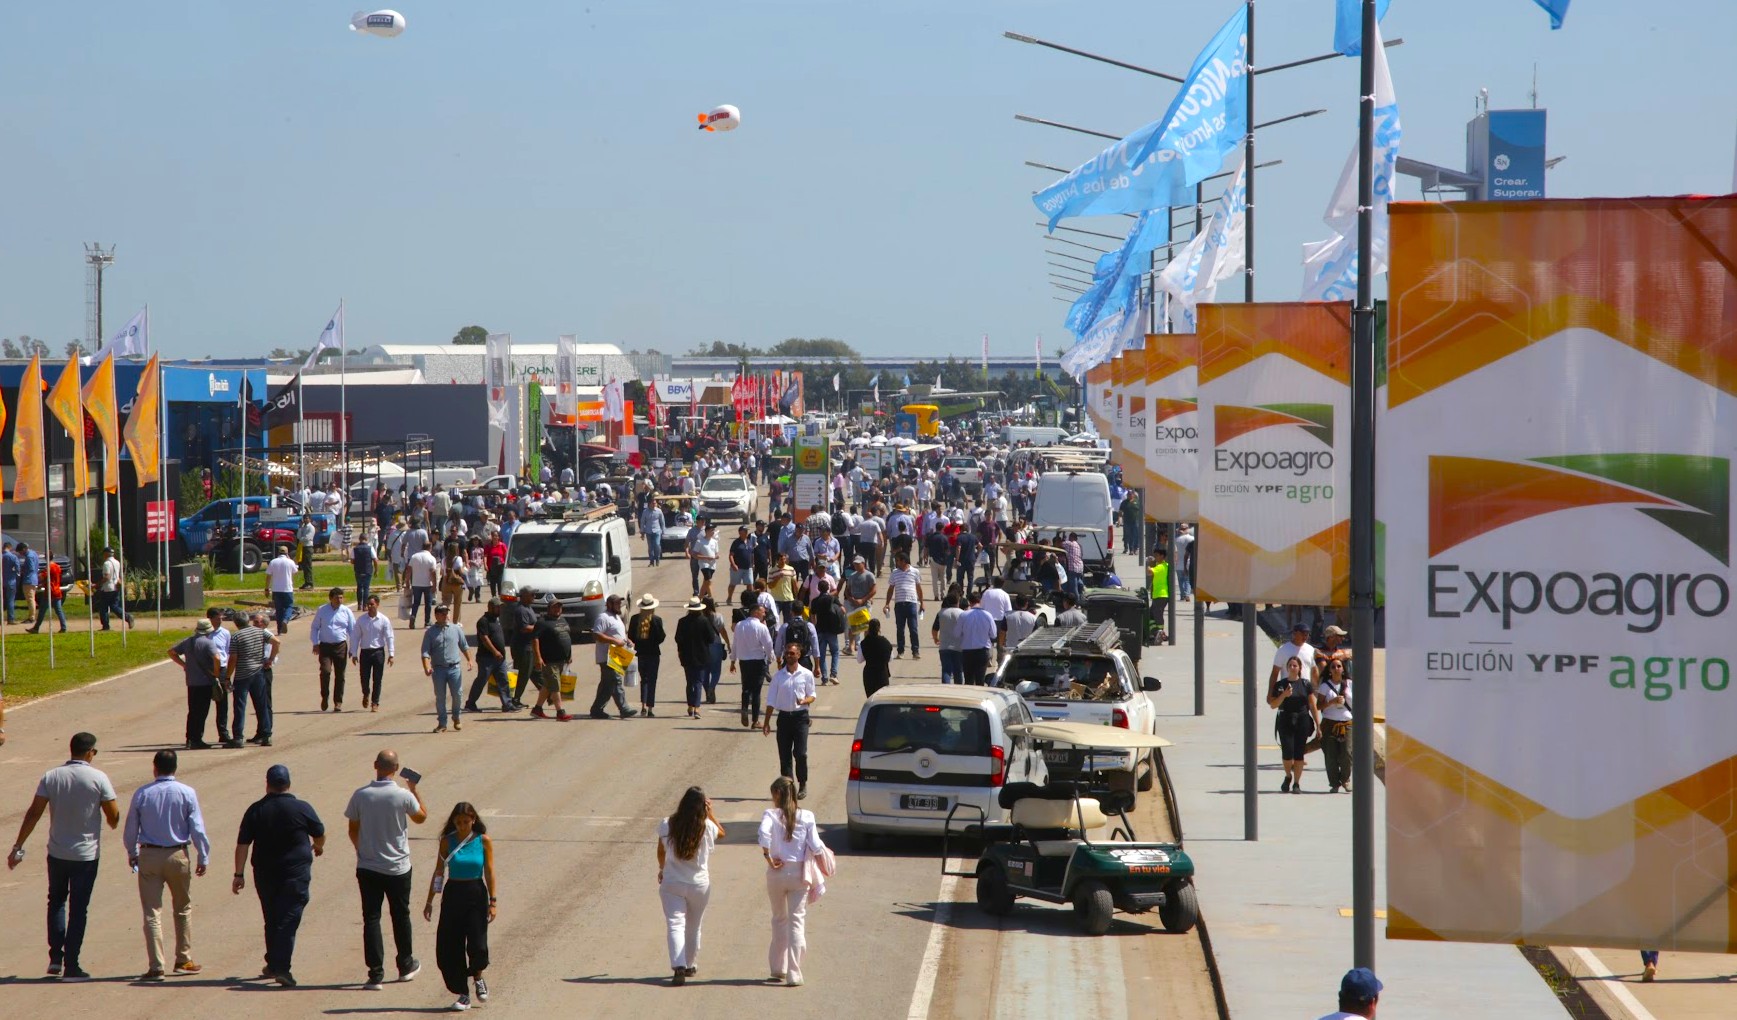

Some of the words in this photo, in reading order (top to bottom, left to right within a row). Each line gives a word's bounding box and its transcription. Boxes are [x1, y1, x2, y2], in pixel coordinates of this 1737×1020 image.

[1494, 178, 1528, 186] Crear.
[1494, 189, 1541, 198] Superar.
[520, 365, 554, 375] JOHN
[577, 367, 598, 375] ERE
[1156, 426, 1198, 443] Expo
[1214, 449, 1334, 476] Expoagro
[1214, 482, 1249, 493] EDICIÓN
[1255, 485, 1283, 493] YPF
[1286, 484, 1334, 504] agro
[1427, 565, 1730, 633] Expoagro
[1427, 650, 1513, 672] EDICIÓN
[1526, 654, 1599, 674] YPF
[1609, 655, 1730, 702] agro
[1129, 865, 1141, 874] En
[1142, 865, 1151, 873] tu
[1152, 864, 1171, 873] vida
